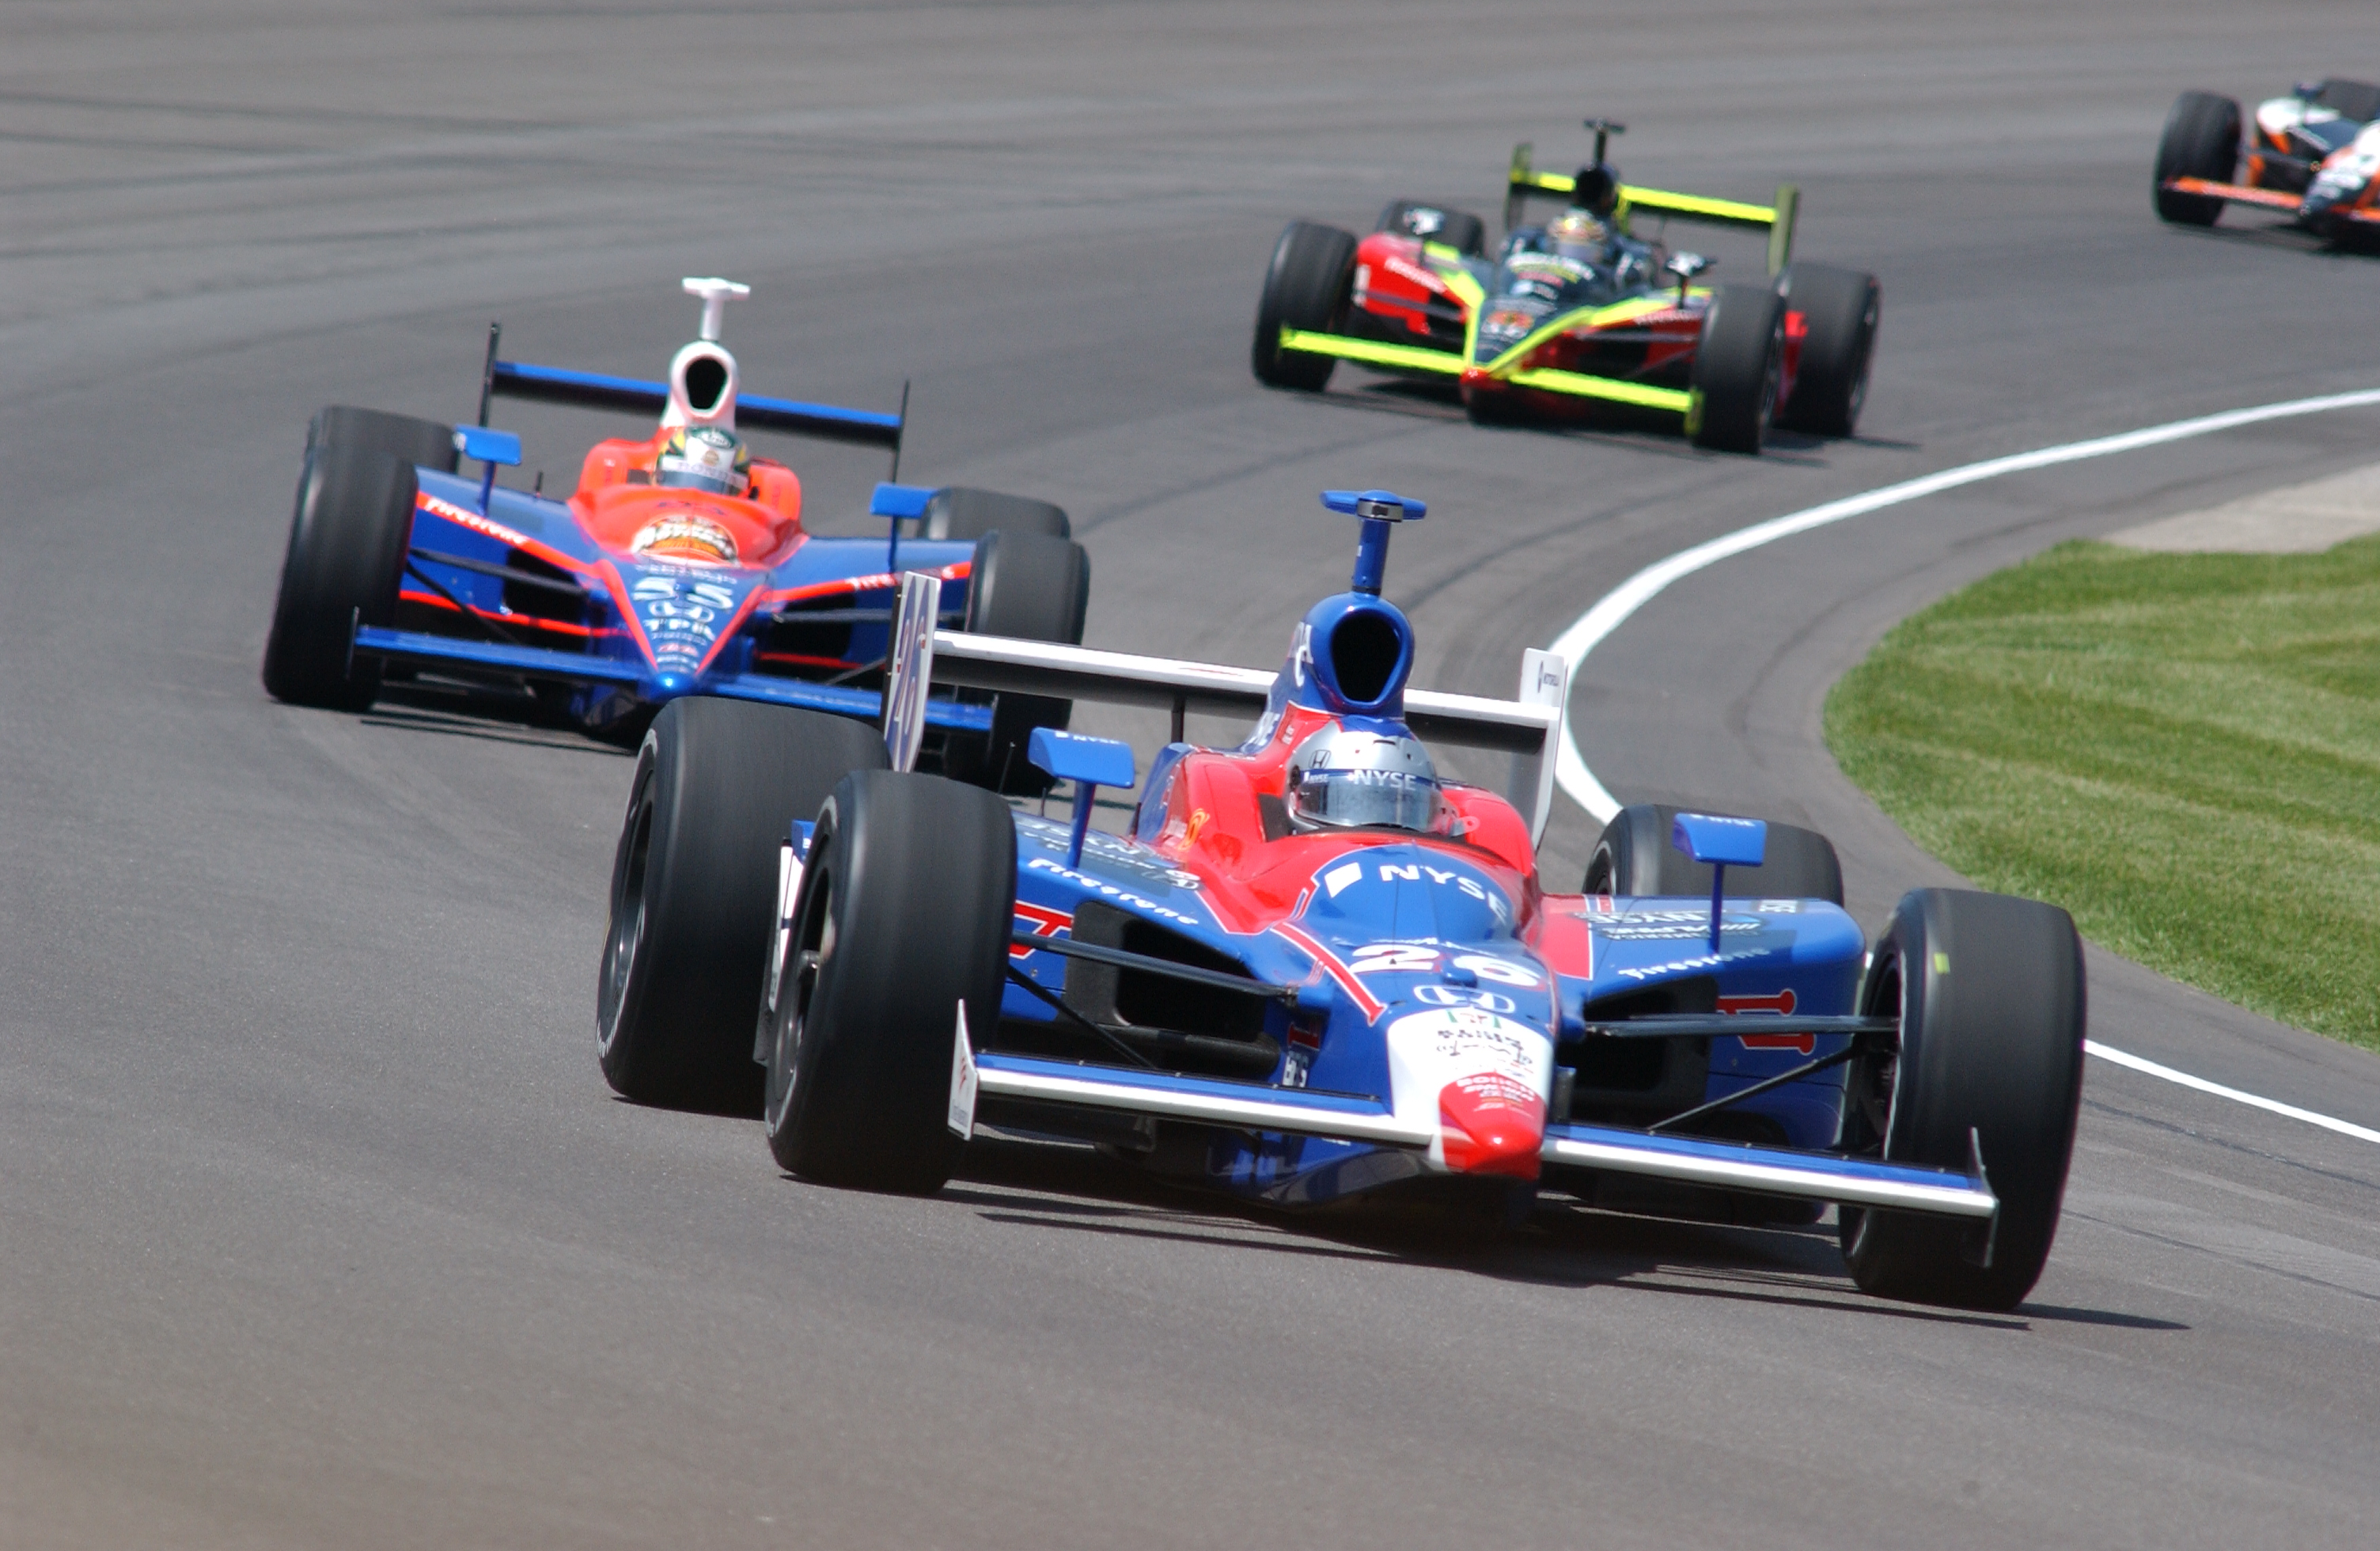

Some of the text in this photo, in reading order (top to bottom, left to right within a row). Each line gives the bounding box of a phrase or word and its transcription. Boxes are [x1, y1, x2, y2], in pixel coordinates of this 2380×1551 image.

[1353, 768, 1416, 791] NYSE
[1379, 865, 1508, 926] NYSE
[1348, 944, 1541, 986] 26
